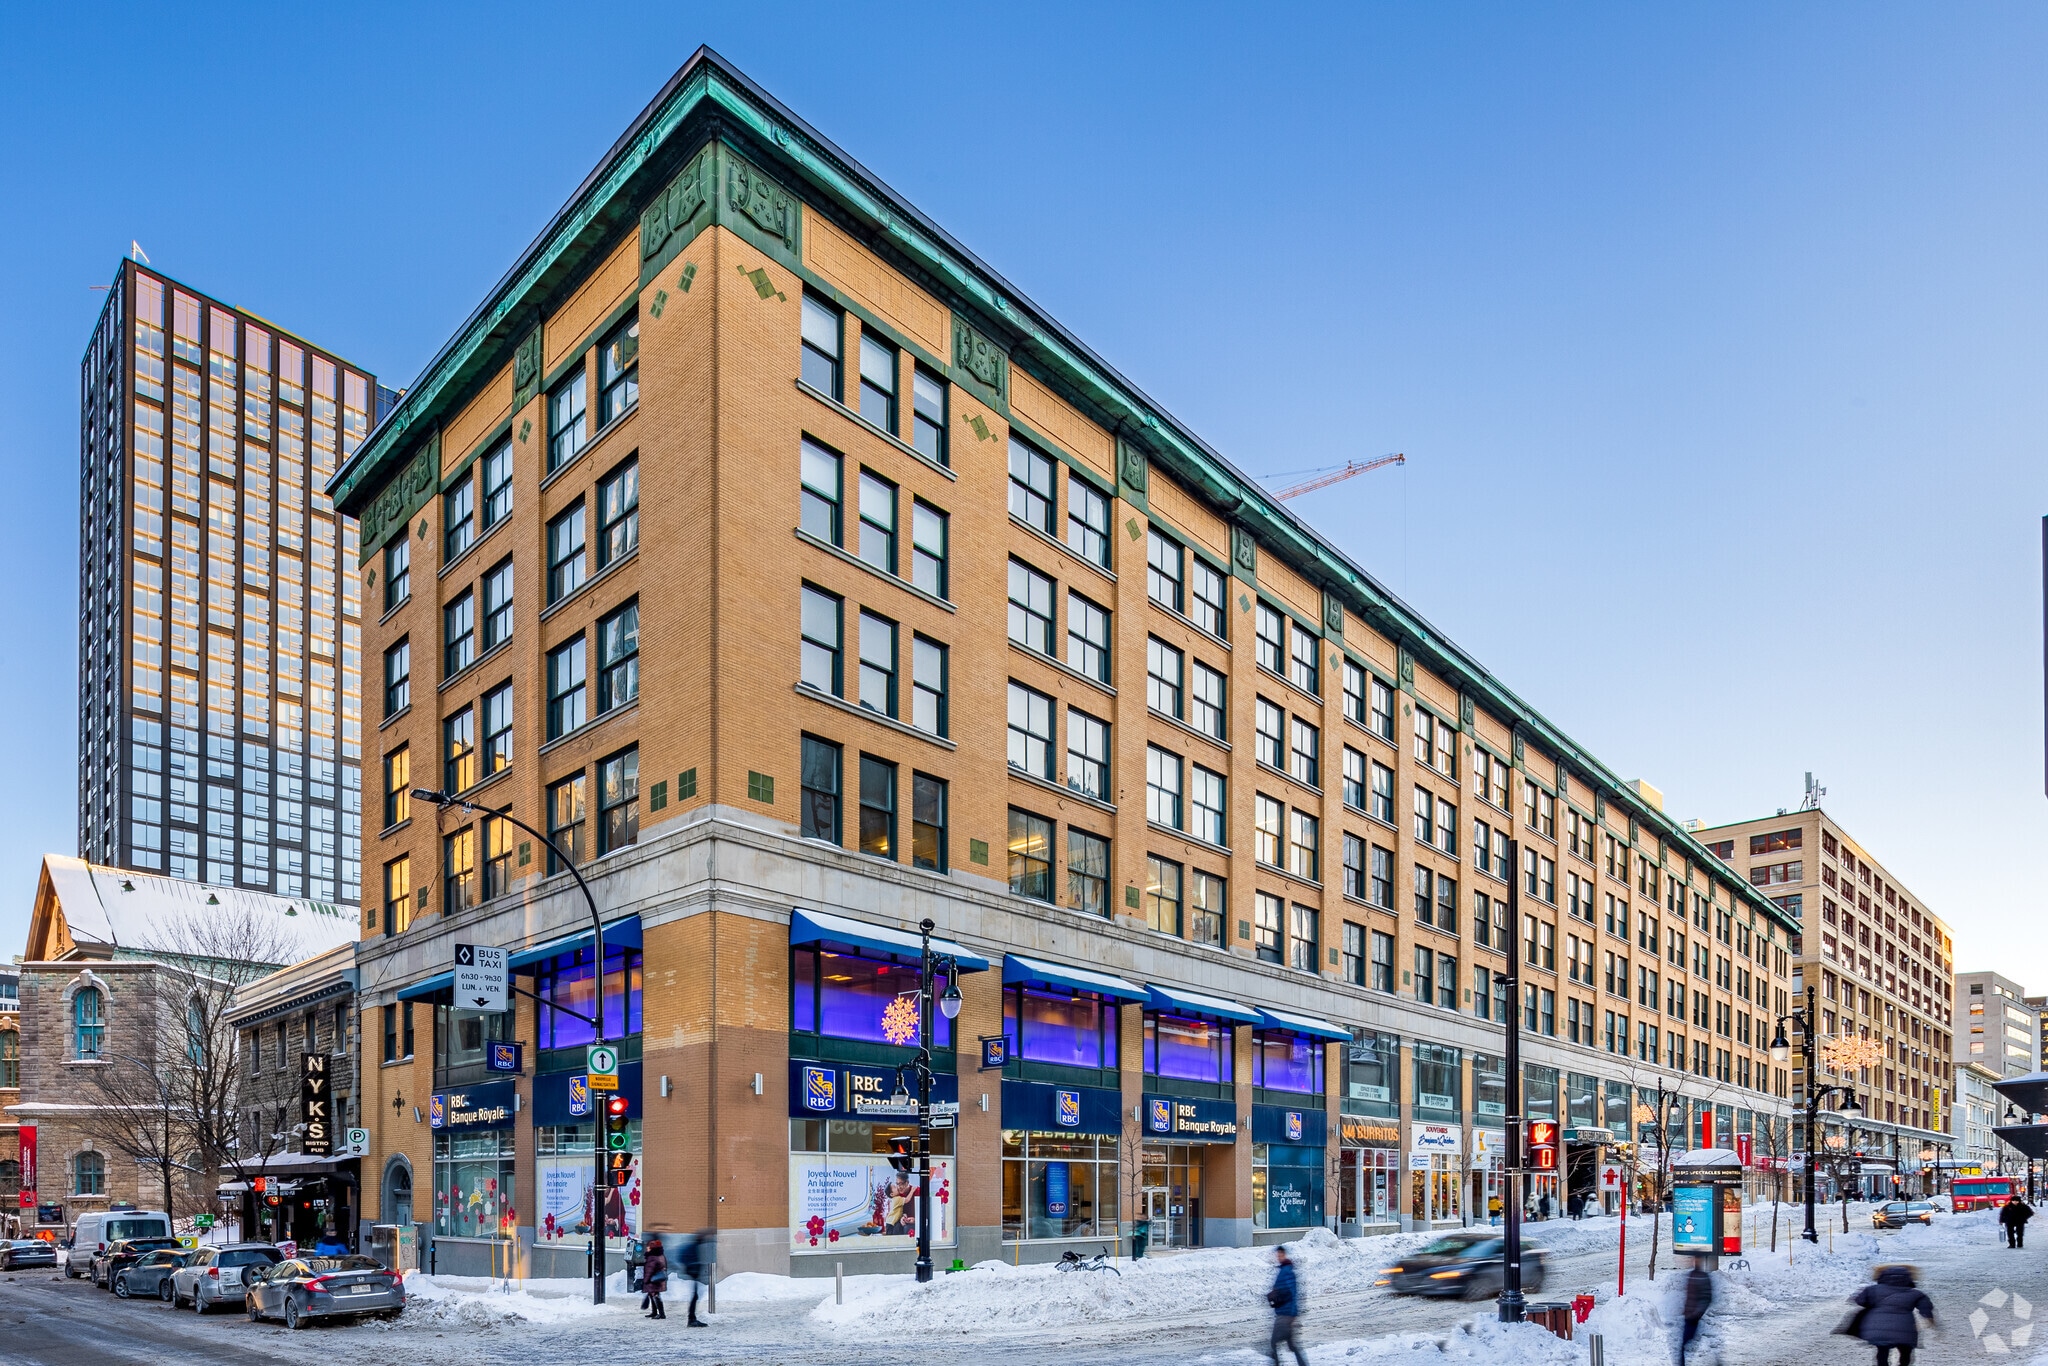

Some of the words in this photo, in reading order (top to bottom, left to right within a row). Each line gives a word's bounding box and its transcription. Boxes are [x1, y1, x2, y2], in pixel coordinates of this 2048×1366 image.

[479, 950, 500, 959] BUS
[479, 960, 502, 968] TAXI
[854, 1076, 883, 1092] RBC
[451, 1095, 465, 1108] RBC
[810, 1098, 832, 1107] RBC
[572, 1103, 585, 1112] RBC
[860, 1106, 908, 1114] Sainte-Catherine
[1179, 1105, 1196, 1117] RBC
[451, 1111, 477, 1125] Banque
[478, 1106, 504, 1123] Royale
[1062, 1115, 1077, 1123] RBC
[1179, 1119, 1210, 1134] Banque
[1210, 1121, 1236, 1135] Royale
[1426, 1126, 1448, 1134] SOUVENIRS
[354, 1132, 361, 1140] P
[1357, 1125, 1399, 1142] BURRITOS
[808, 1170, 831, 1179] Joyeux
[1272, 1190, 1302, 1198] Ste-Catherine
[1280, 1198, 1288, 1213] &
[1292, 1198, 1307, 1207] Bleury
[197, 1216, 204, 1225] P
